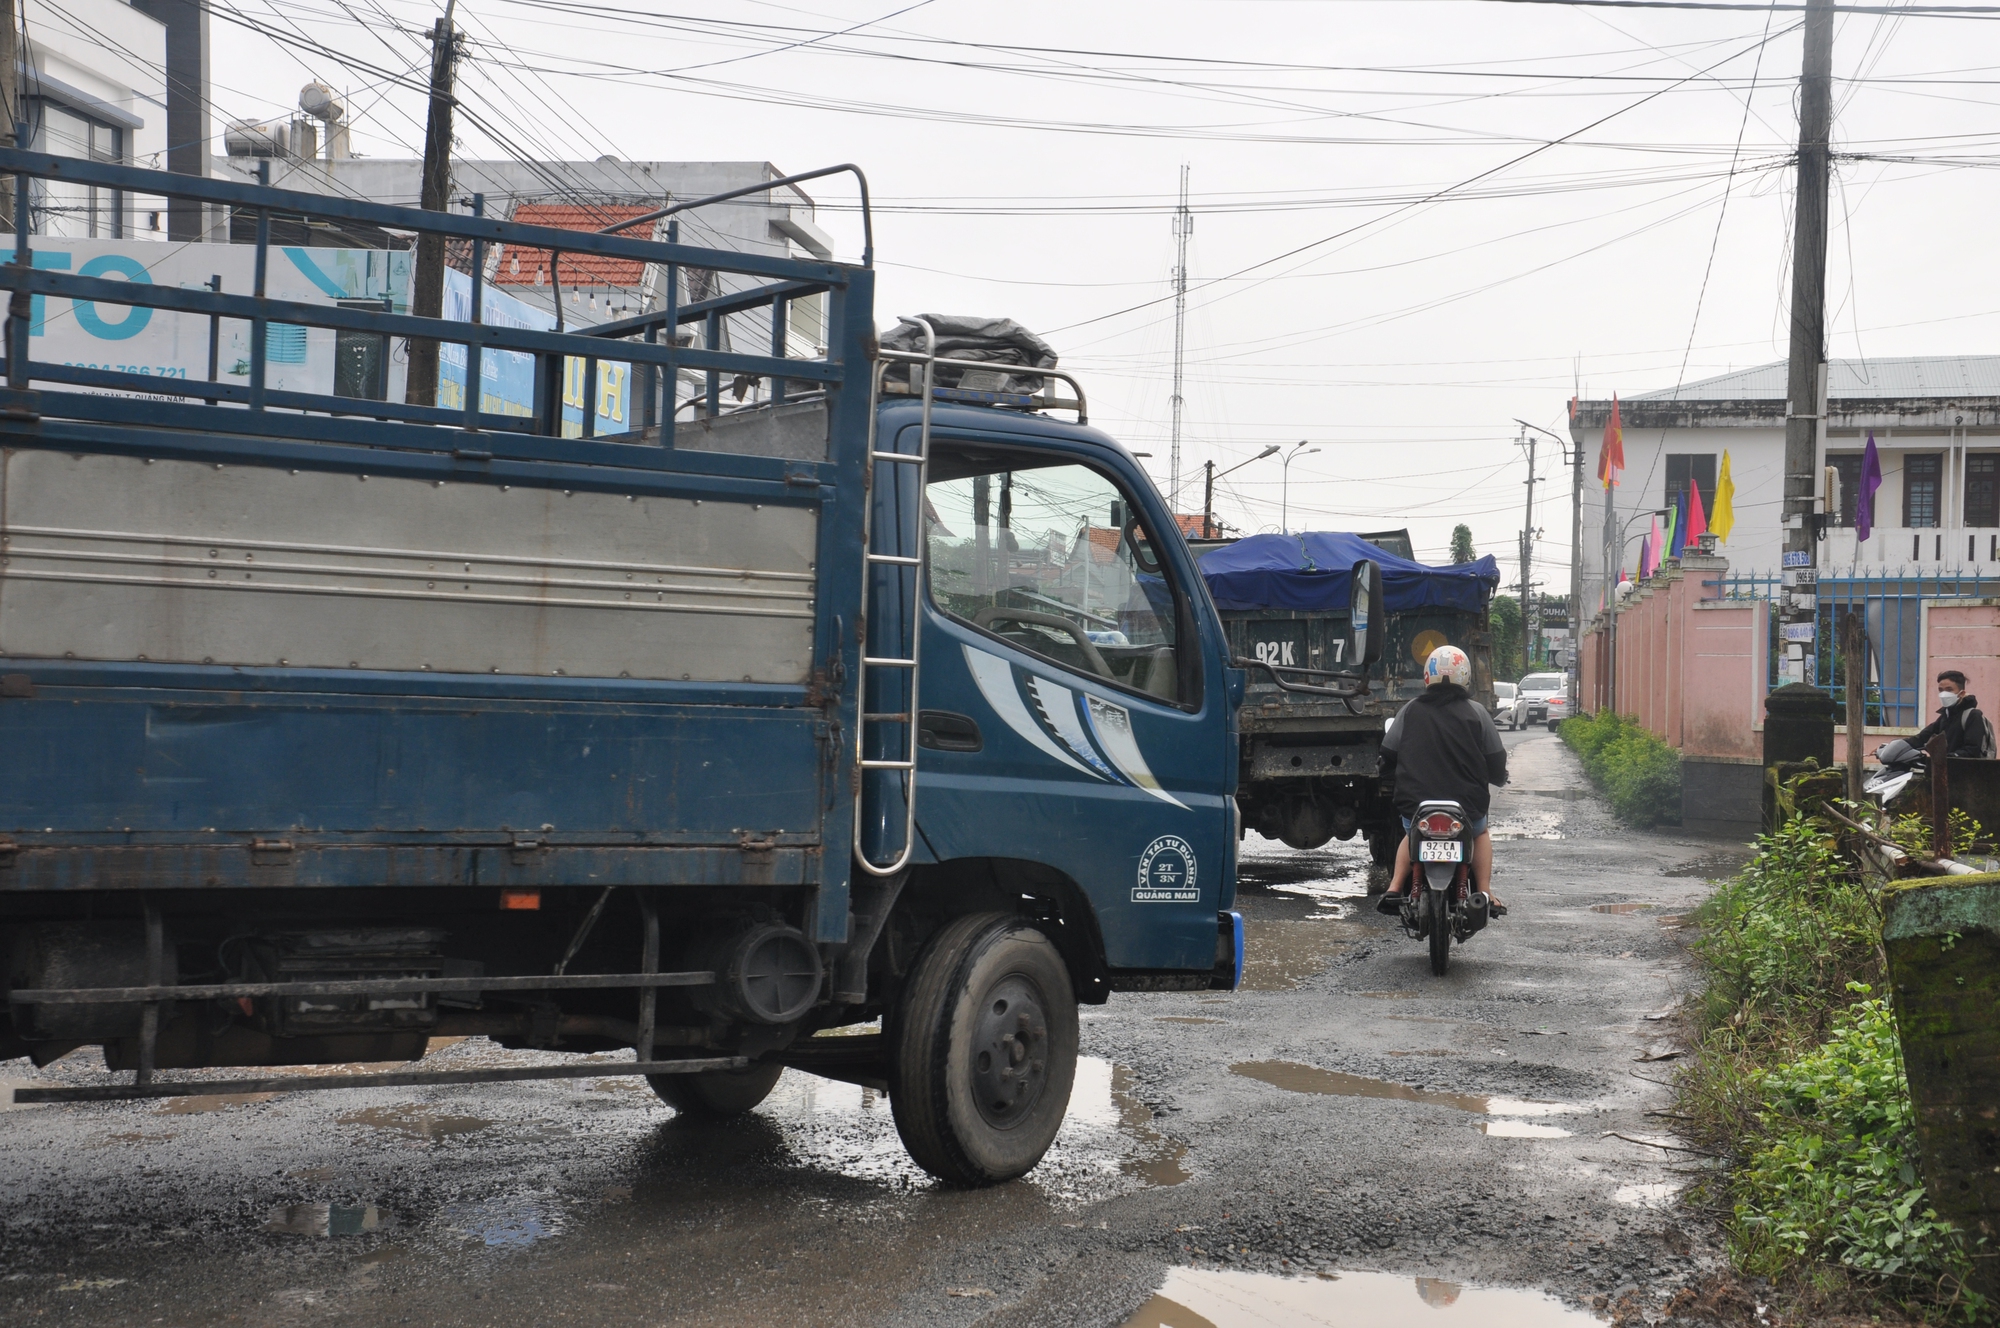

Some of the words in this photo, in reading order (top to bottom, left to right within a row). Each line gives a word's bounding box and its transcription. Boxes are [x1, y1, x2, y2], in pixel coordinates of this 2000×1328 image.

[1256, 641, 1295, 665] 92K
[1158, 863, 1173, 871] 2T
[1160, 875, 1176, 883] 3N
[1136, 890, 1172, 899] QUẢNG
